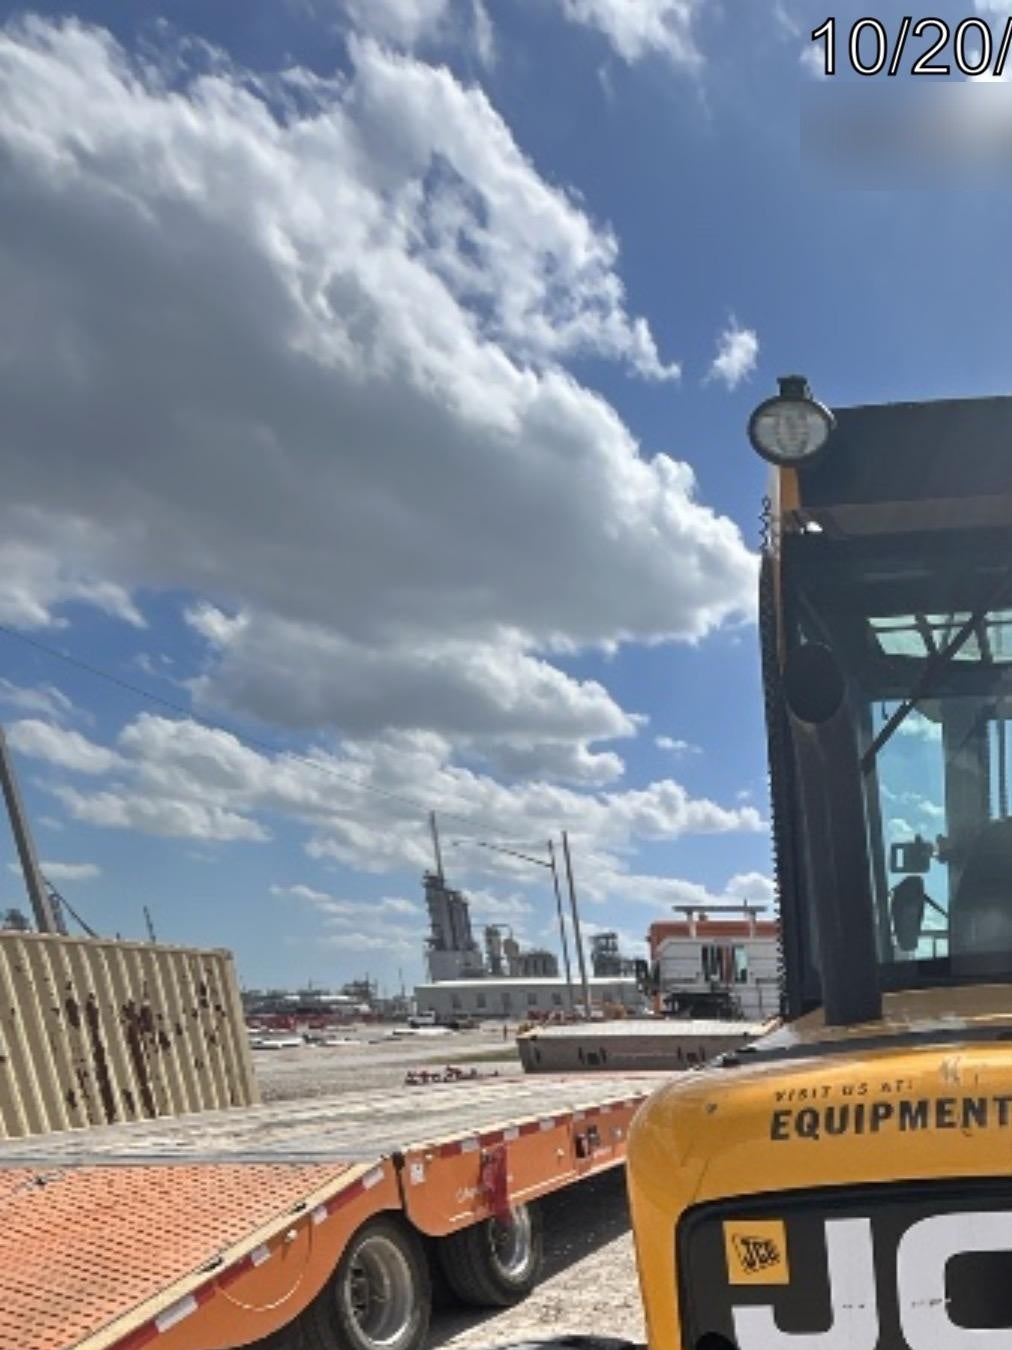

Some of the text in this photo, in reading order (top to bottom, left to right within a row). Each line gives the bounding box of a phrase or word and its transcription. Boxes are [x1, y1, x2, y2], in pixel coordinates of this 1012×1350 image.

[774, 1085, 831, 1102] VISIT
[842, 1082, 868, 1096] US
[735, 1235, 781, 1272] JCB
